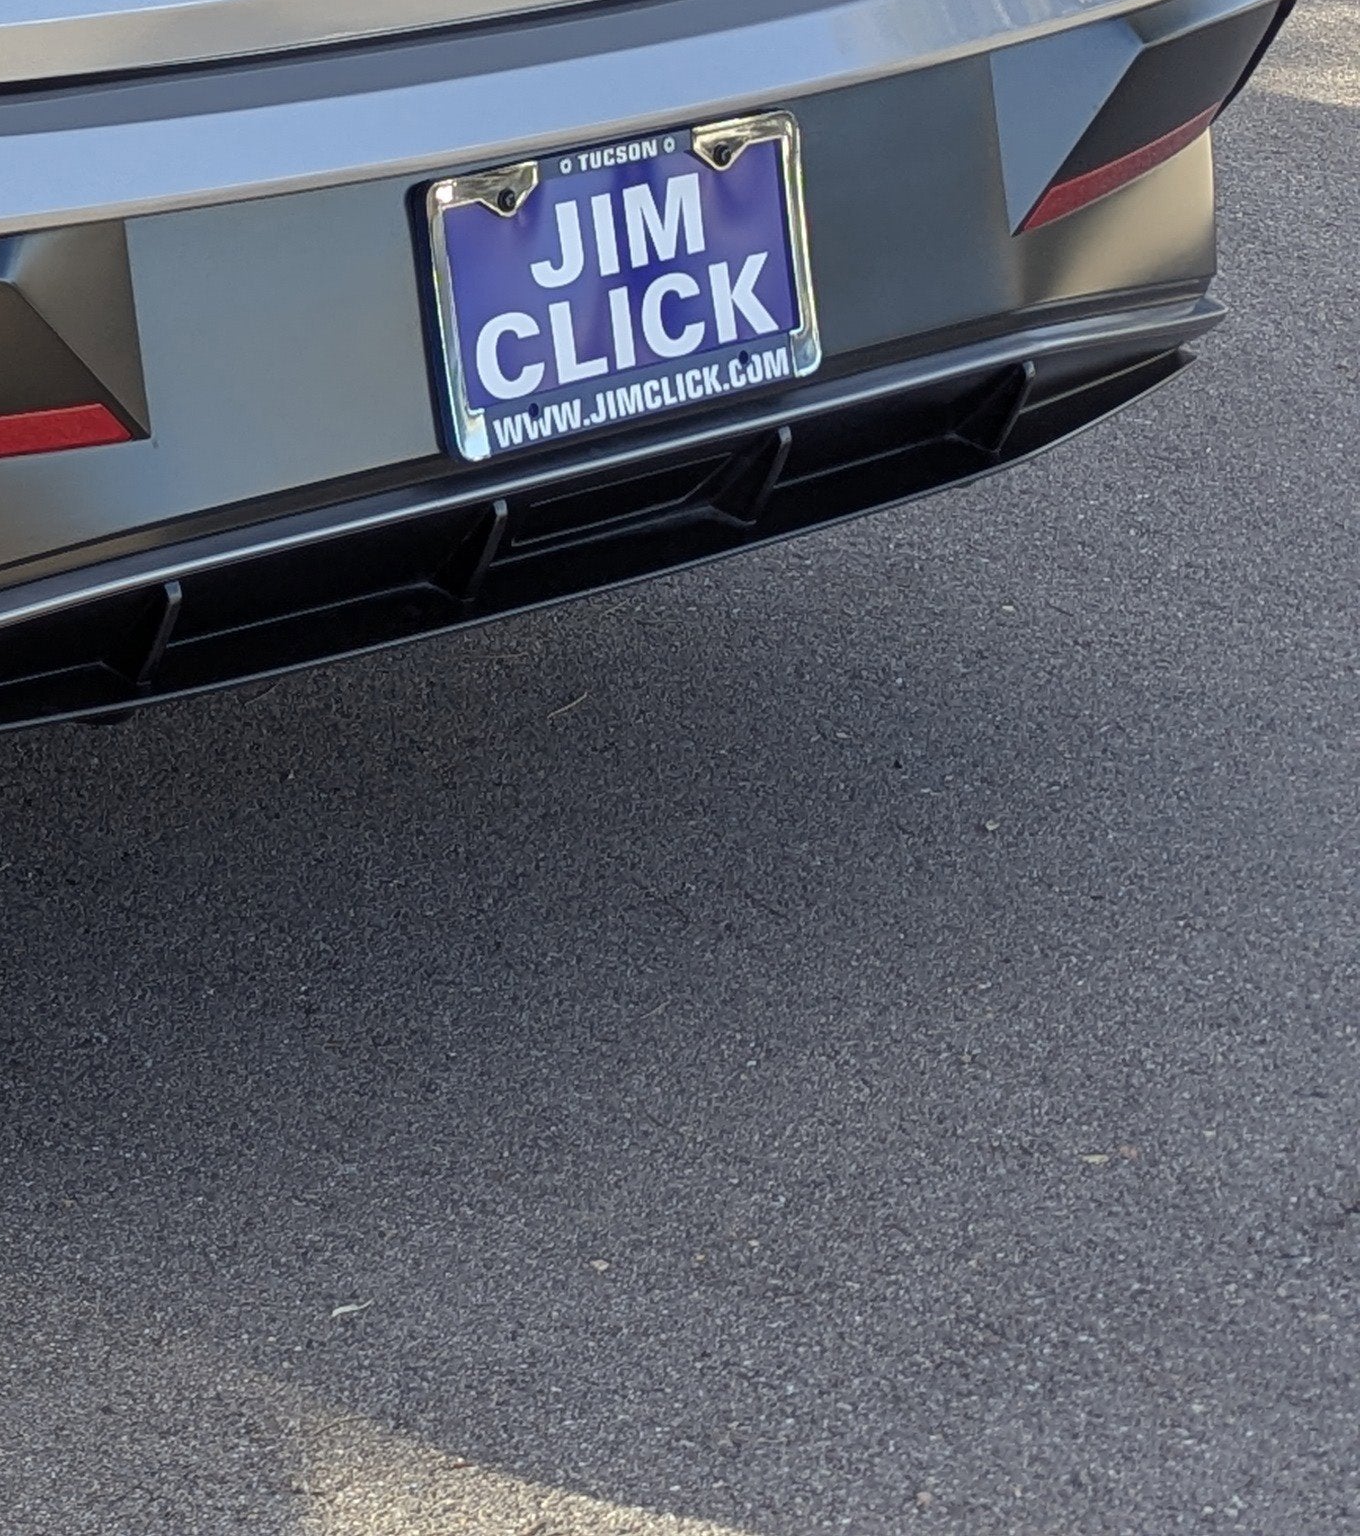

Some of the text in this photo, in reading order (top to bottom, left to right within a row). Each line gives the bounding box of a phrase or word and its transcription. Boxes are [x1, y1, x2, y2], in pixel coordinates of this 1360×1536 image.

[577, 140, 658, 172] TUCSON
[530, 172, 706, 289] JIM
[475, 251, 780, 401] CLICK
[492, 346, 790, 449] WWW.JIMCLICK.COM
